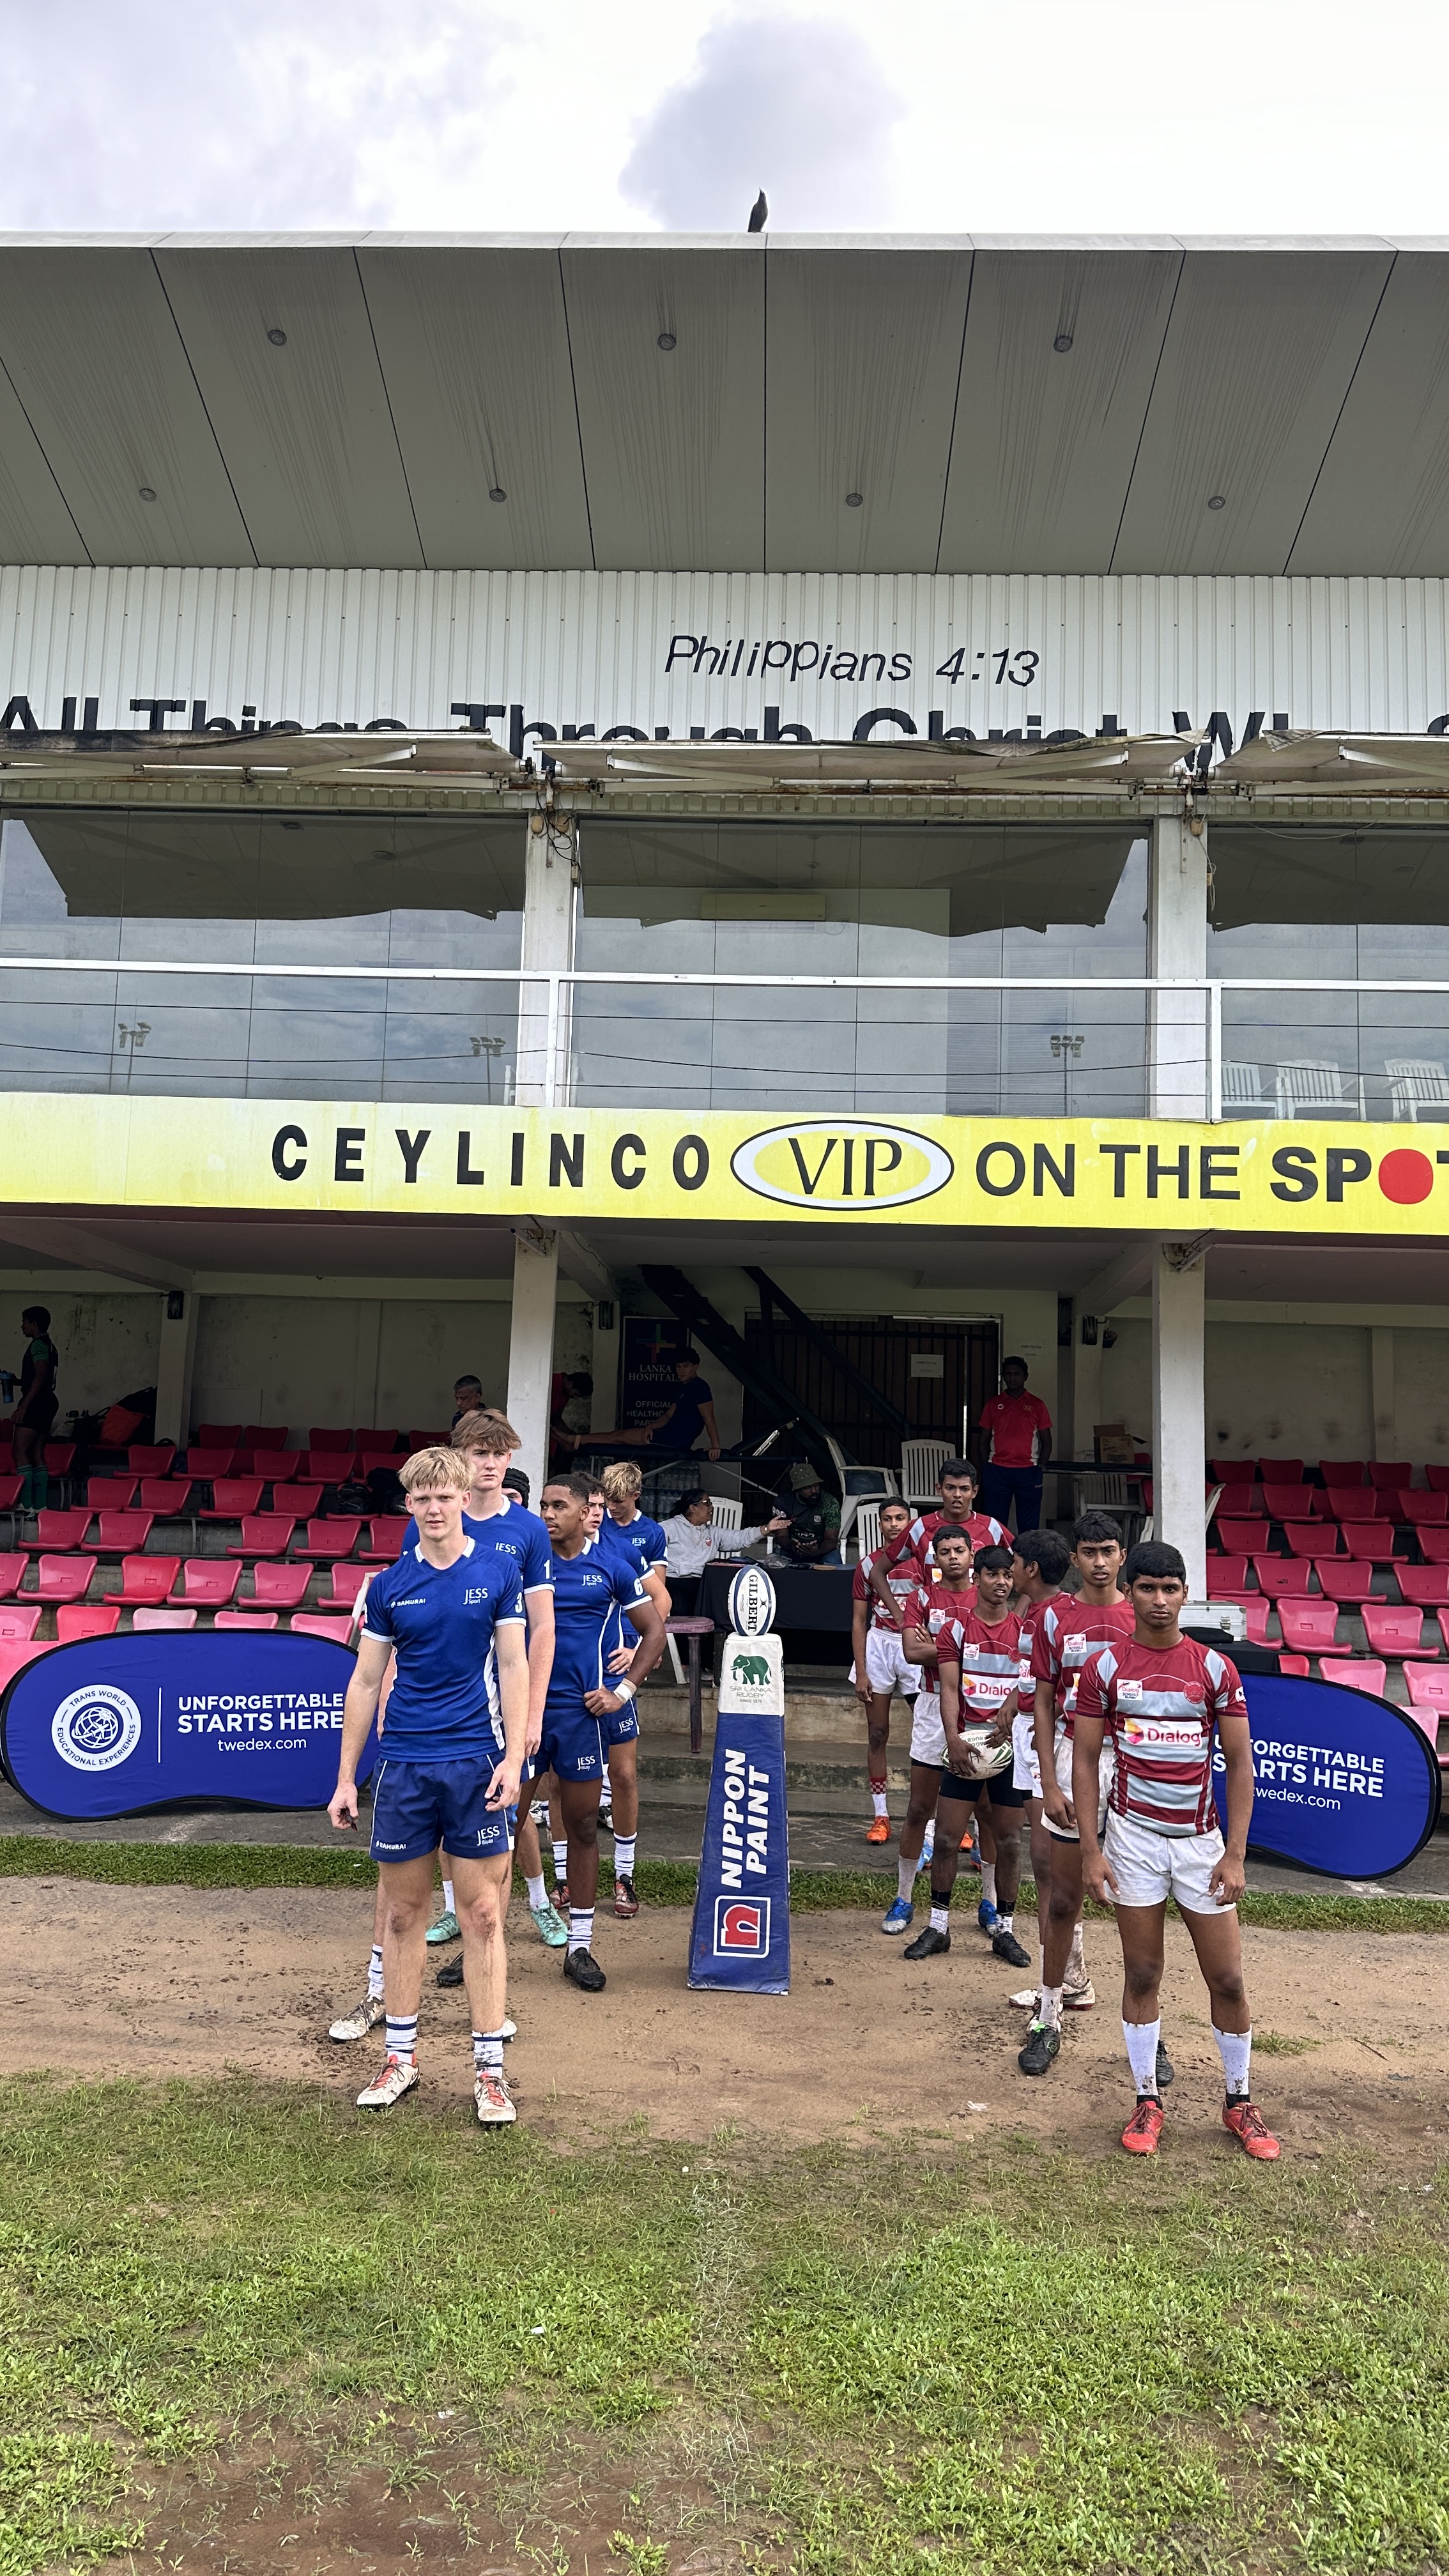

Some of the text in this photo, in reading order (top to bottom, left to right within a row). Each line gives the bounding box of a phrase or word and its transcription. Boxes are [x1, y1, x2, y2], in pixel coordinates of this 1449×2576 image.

[665, 635, 1039, 687] Philippians 4:13
[272, 1124, 709, 1191] CEYLINCO
[788, 1137, 902, 1196] VIP
[976, 1142, 1075, 1197] ON
[1100, 1144, 1241, 1200] THE
[640, 1364, 672, 1373] LANKA
[582, 1575, 602, 1586] JESS
[634, 1577, 643, 1596] 6
[397, 1598, 426, 1607] SAMURAI
[463, 1588, 488, 1605] JESS
[514, 1591, 523, 1614] 3
[747, 1574, 758, 1632] GILBERT
[69, 1690, 126, 1707] TRANS WORLD
[979, 1682, 1015, 1696] Dialo
[178, 1693, 344, 1711] UNFORGETTABLE
[178, 1710, 344, 1733] STARTS HERE
[618, 1717, 634, 1733] JESS
[57, 1724, 136, 1766] EDUCATIONAL EXPERIENCES
[217, 1738, 307, 1752] twedex.com
[1147, 1727, 1202, 1747] Dialog
[577, 1755, 595, 1771] JESS
[1314, 1767, 1384, 1798] HERE
[721, 1749, 746, 1889] NIPPON
[746, 1765, 769, 1874] PAINT
[477, 1825, 500, 1846] JESS
[379, 1842, 406, 1850] SAMURAI
